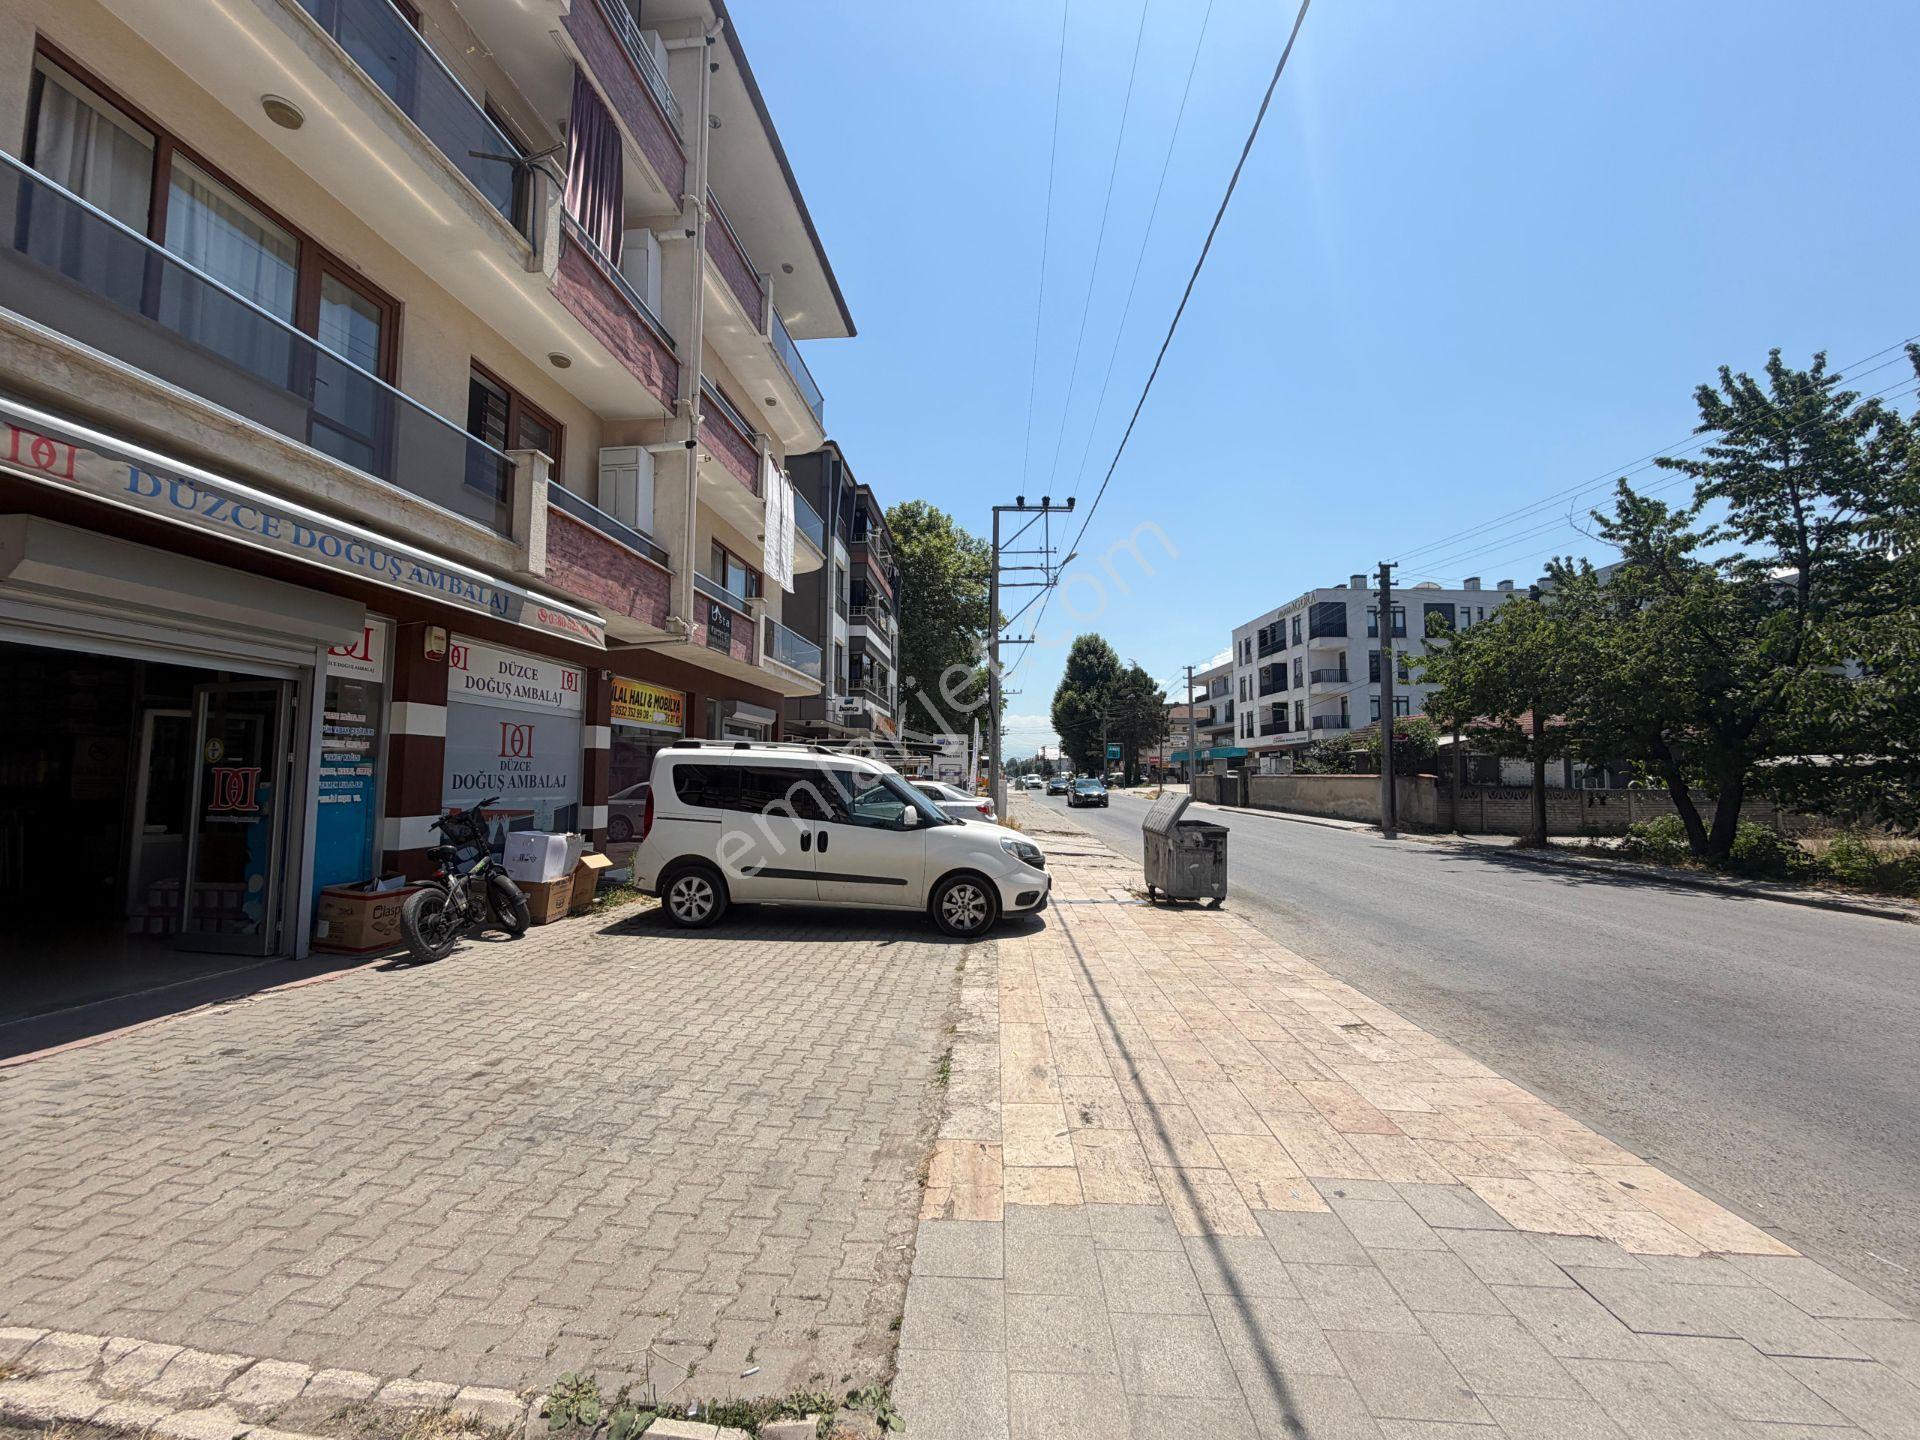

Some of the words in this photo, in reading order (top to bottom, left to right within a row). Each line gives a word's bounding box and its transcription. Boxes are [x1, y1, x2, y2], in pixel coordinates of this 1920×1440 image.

[124, 464, 281, 539] DÜZCE
[289, 524, 403, 580] DOĞUŞ
[409, 565, 510, 615] AMBALAJ
[498, 660, 539, 681] DÜZCE
[465, 675, 512, 698] DOĞUŞ
[513, 685, 563, 706] AMBALAJ
[629, 689, 646, 708] HALI
[647, 692, 653, 708] &
[653, 694, 680, 713] MOBİLYA
[500, 758, 532, 772] DÜZCE
[452, 771, 505, 792] DOĞUŞ
[506, 774, 567, 789] AMBALAJ
[372, 904, 403, 920] Clasp
